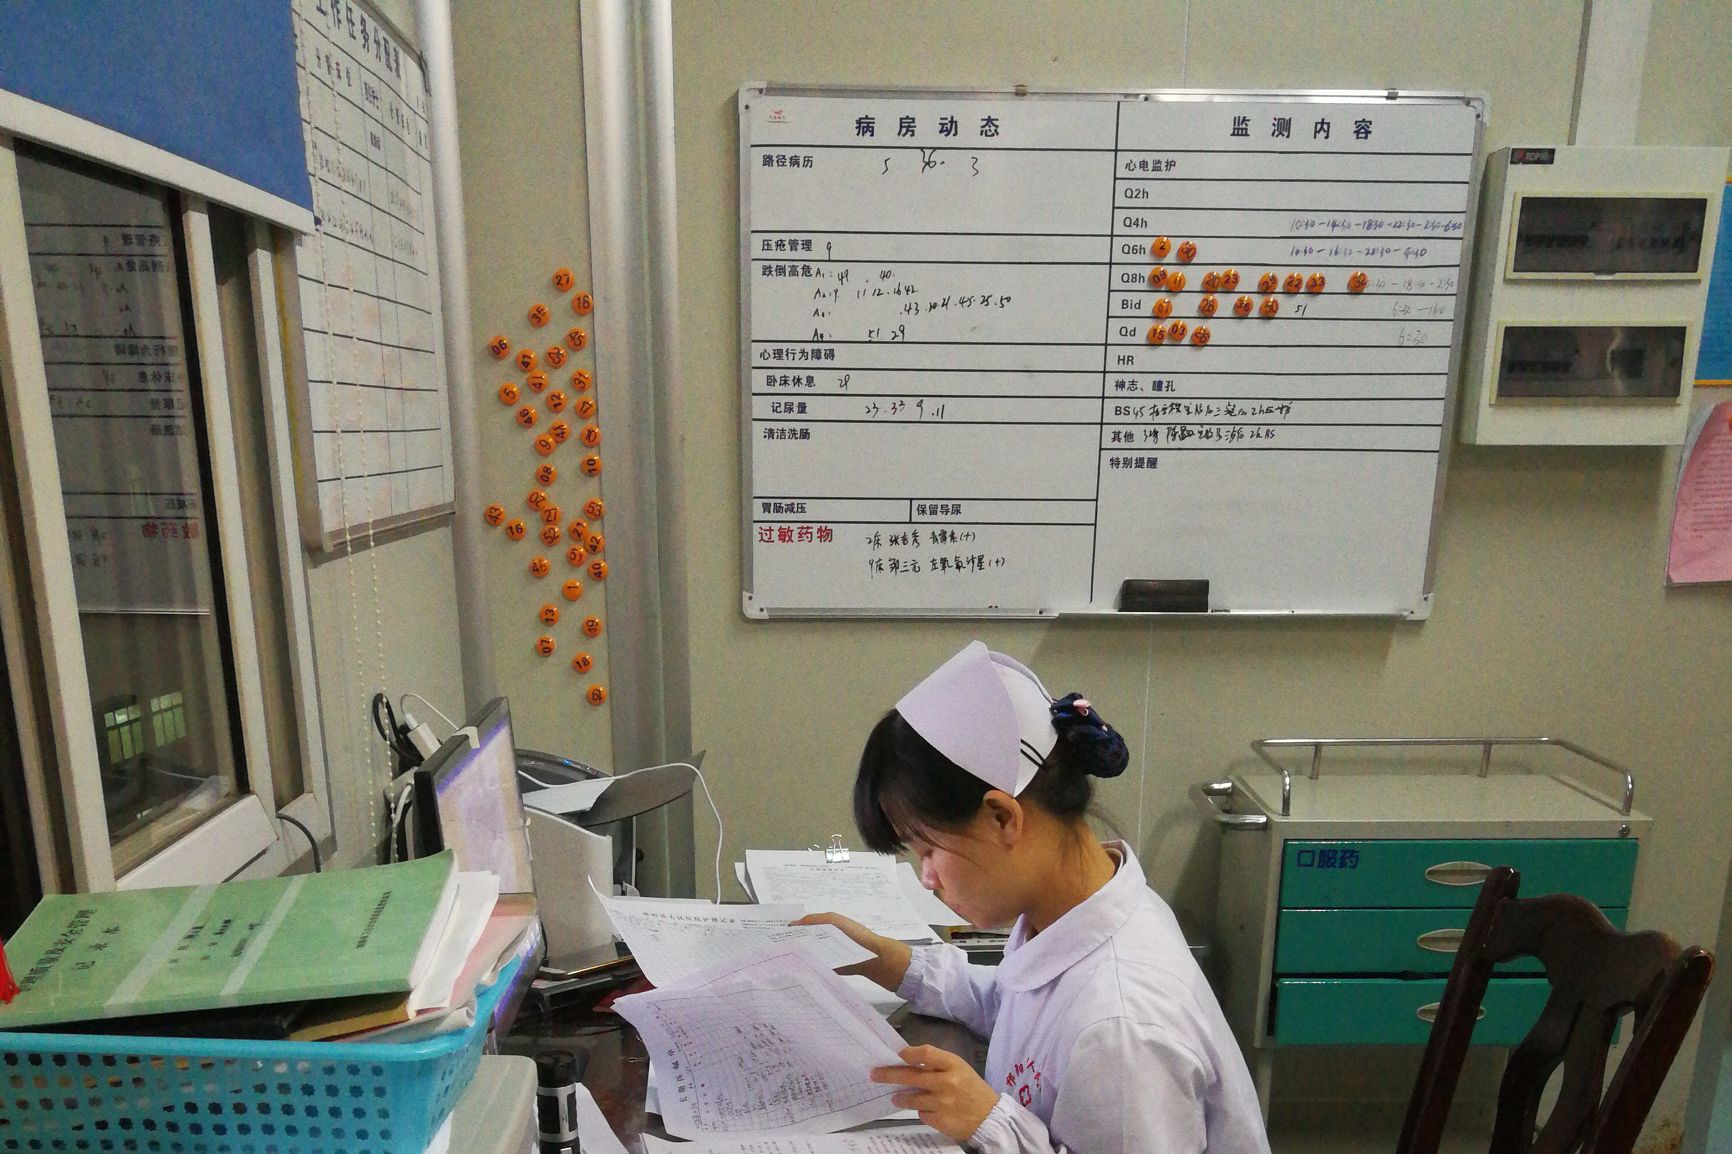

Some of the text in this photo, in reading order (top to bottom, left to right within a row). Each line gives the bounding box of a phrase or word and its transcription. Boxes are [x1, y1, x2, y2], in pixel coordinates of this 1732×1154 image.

[854, 114, 1001, 138] 病房动态
[1230, 116, 1373, 140] 监测内容
[762, 154, 814, 169] 路径病历
[1125, 158, 1177, 172] 心电监护
[1124, 187, 1149, 200] Q2h
[1123, 216, 1148, 229] Q4h
[761, 238, 813, 252] 压疮管理
[1121, 243, 1146, 256] Q6h
[761, 264, 813, 278] 跌倒高危
[1120, 272, 1145, 285] Q8h
[1121, 299, 1141, 311] Bid
[1119, 326, 1136, 338] Qd
[760, 348, 835, 362] 心理行为障碍
[1117, 355, 1135, 366] HR
[766, 374, 816, 388] 卧床休息
[1114, 379, 1176, 392] 神志、瞳孔
[771, 402, 808, 415] 记尿量
[1114, 405, 1130, 416] BS
[763, 427, 811, 441] 清洁洗肠
[1111, 430, 1135, 443] 其他
[1109, 457, 1158, 470] 特别提醒
[761, 501, 808, 515] 胃肠减压
[916, 503, 962, 517] 保留导尿
[758, 525, 834, 544] 过敏药物
[1296, 848, 1360, 869] 口服药
